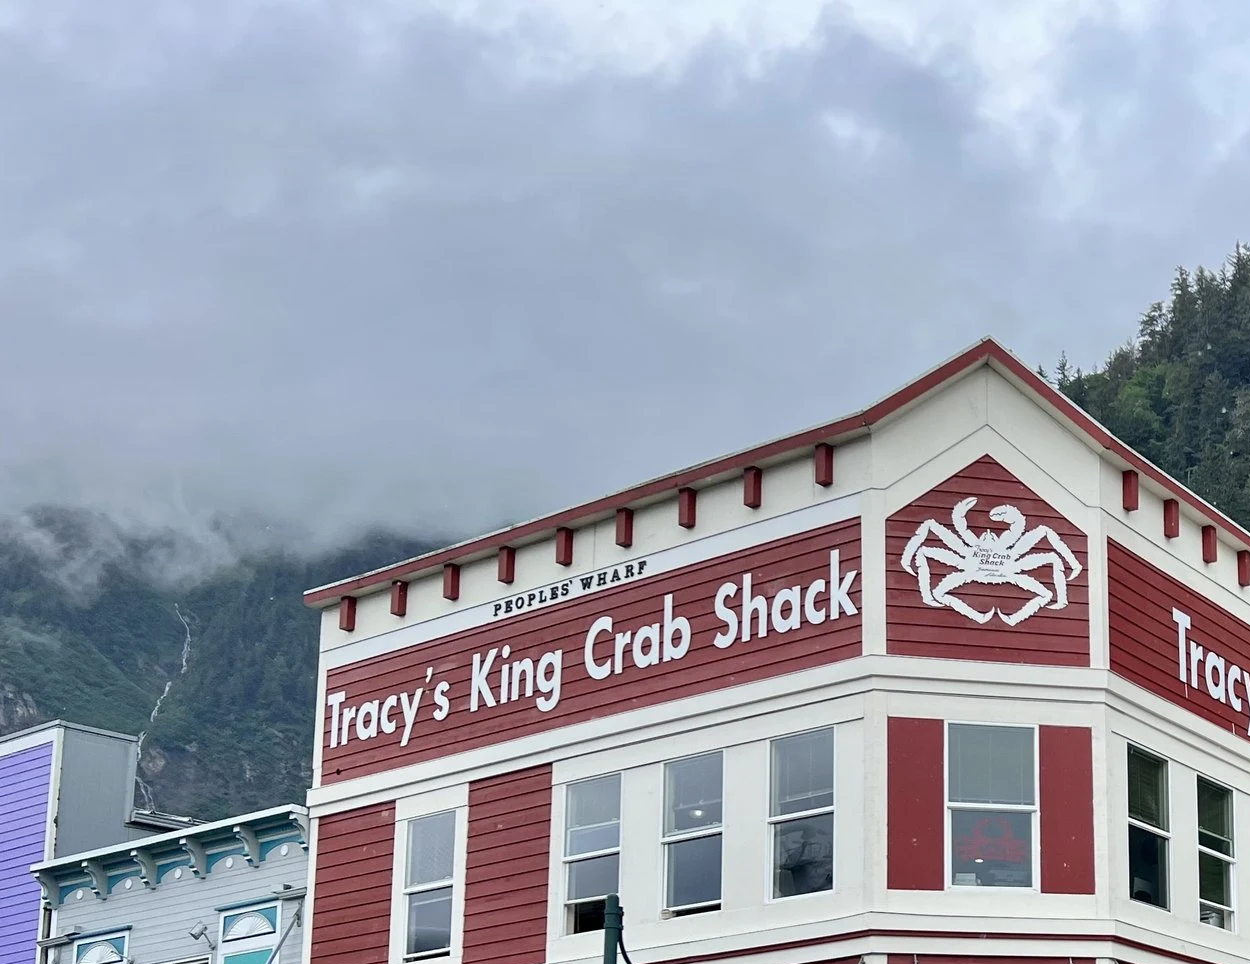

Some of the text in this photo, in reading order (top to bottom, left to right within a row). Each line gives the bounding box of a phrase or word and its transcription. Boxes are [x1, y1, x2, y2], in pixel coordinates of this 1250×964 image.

[973, 551, 992, 559] King
[493, 560, 647, 617] PEOPLES' WHARF
[327, 549, 859, 748] Tracy's King Crab Shack
